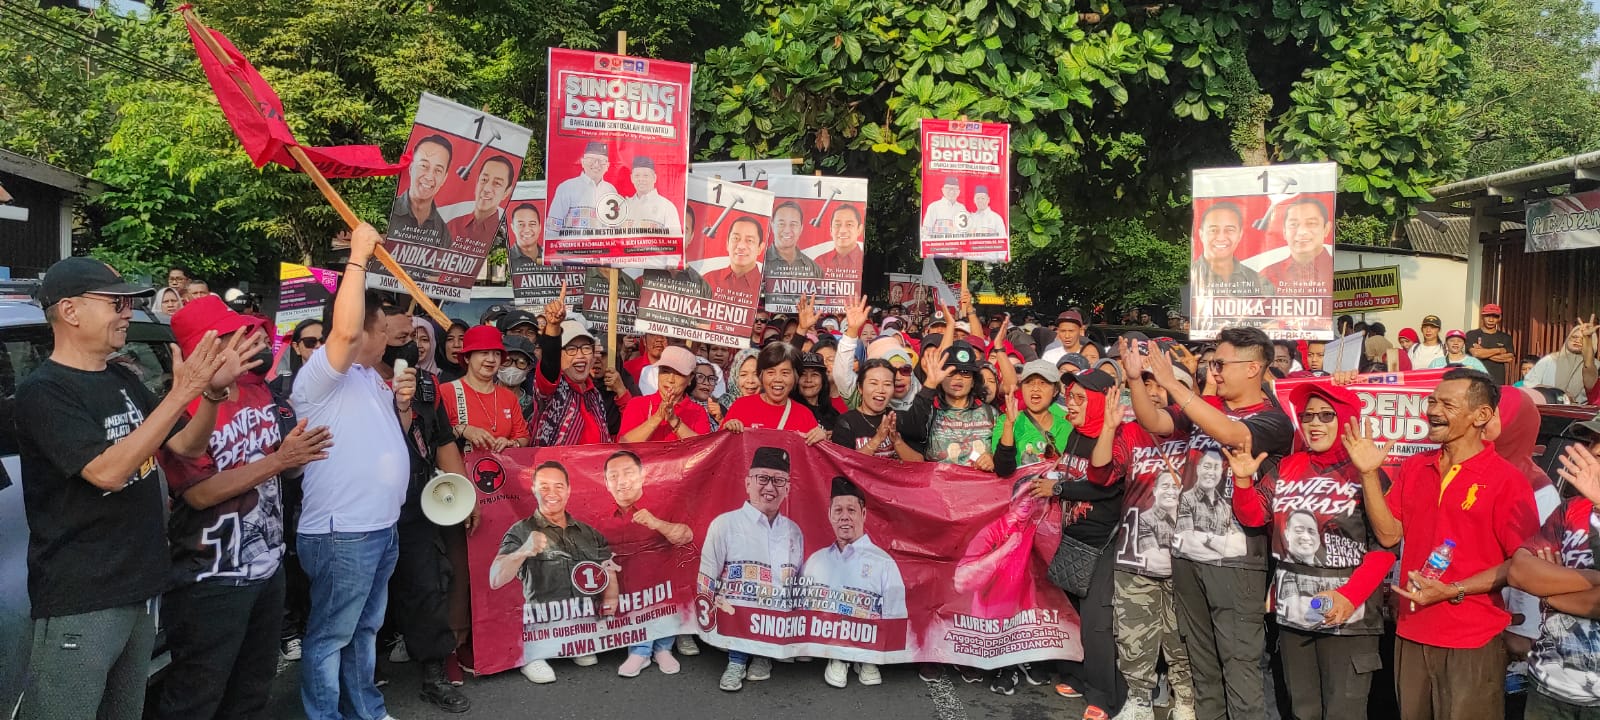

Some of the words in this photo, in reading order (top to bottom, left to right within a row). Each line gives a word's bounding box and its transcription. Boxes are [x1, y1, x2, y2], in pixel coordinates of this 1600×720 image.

[566, 75, 676, 105] SINOENG
[565, 94, 673, 124] berBUDI
[474, 116, 485, 139] 1
[930, 135, 1000, 151] SINOENG
[930, 147, 999, 164] berBUDI
[738, 162, 747, 179] 1
[1257, 170, 1269, 193] 1
[712, 183, 722, 204] 1
[813, 180, 822, 197] 1
[605, 199, 620, 220] 3
[958, 214, 968, 228] 3
[390, 243, 478, 275] ANDIKA-HENDI
[431, 285, 461, 298] PERKASA
[772, 279, 855, 296] ANDIKA-HENDI
[591, 296, 639, 315] ANIKA-
[648, 292, 748, 325] ANDIKA-HENDI
[647, 322, 669, 333] JAWA
[672, 325, 703, 339] TENGAH
[705, 332, 740, 346] PERKASA
[1356, 392, 1429, 417] OEN
[209, 403, 277, 458] BANTENG
[216, 422, 282, 473] PERKASA
[1274, 476, 1363, 499] BANTENG
[196, 512, 249, 583] 1
[582, 567, 598, 589] 1
[522, 596, 596, 625] ANDIKA
[618, 580, 673, 613] HENDI
[714, 579, 768, 595] WALIKOTA
[791, 588, 824, 599] WAKIL
[828, 588, 885, 606] WALIKOTA
[698, 599, 710, 626] 3
[758, 598, 787, 609] KOTA
[788, 598, 836, 611] SALATIGA
[522, 629, 550, 643] CALON
[552, 622, 597, 639] GUBERNUR
[606, 617, 633, 631] WAKIL
[635, 604, 678, 624] GUBERNUR
[750, 613, 807, 638] SINOENG
[811, 616, 878, 644] berBUDI
[953, 613, 1000, 633] LAURENS
[1043, 609, 1060, 624] S.T
[558, 638, 596, 657] JAWA
[599, 627, 648, 650] TENGAH
[944, 631, 984, 647] Anggota
[985, 636, 1011, 648] DPRD
[1011, 630, 1032, 642] Kota
[1032, 628, 1069, 640] Salatiga
[954, 643, 983, 657] Fraksi
[983, 649, 998, 658] PDI
[999, 638, 1064, 655] PERJUANGAN
